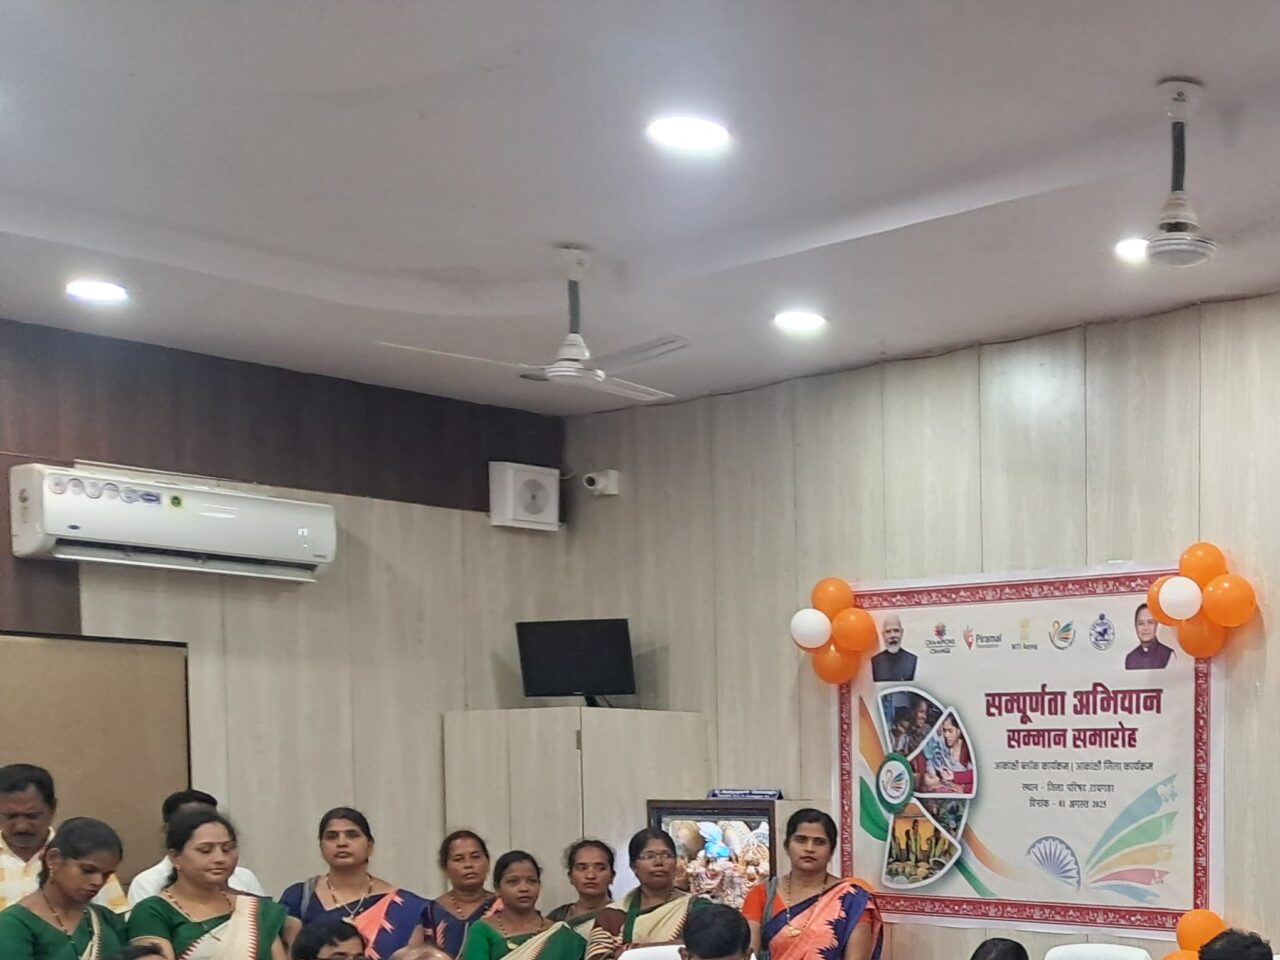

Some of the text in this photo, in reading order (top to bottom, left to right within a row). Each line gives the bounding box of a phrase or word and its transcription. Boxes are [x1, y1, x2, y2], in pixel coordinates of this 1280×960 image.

[985, 682, 1163, 724] सम्पूर्णता अभियान
[1006, 721, 1138, 749] सम्मान समारोह
